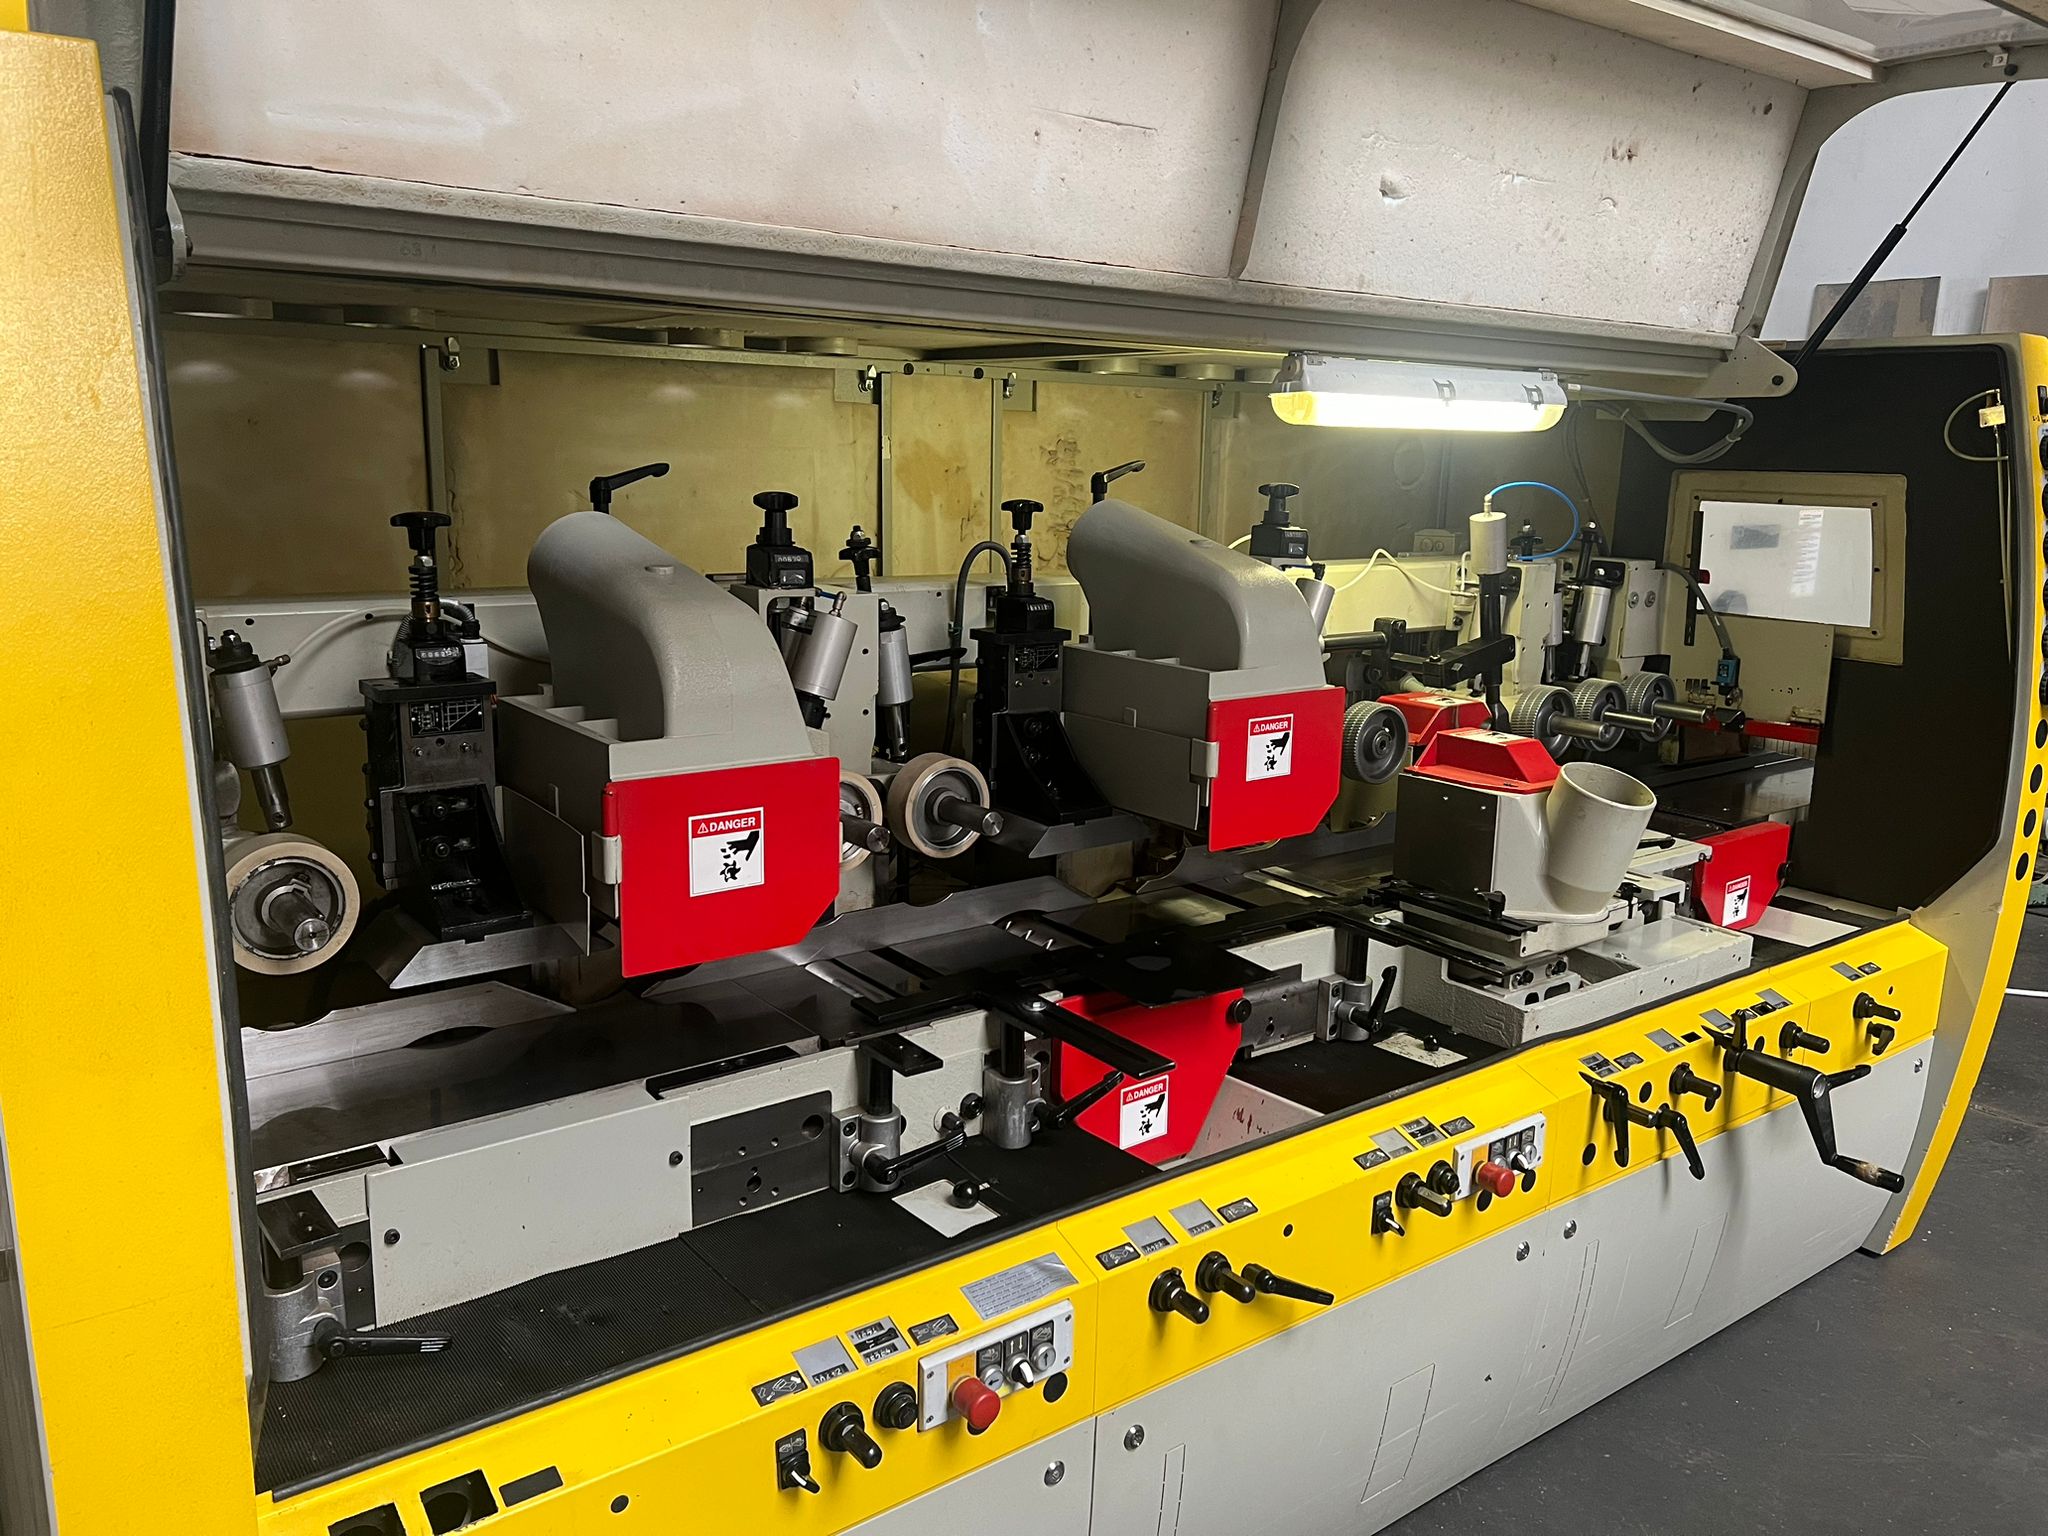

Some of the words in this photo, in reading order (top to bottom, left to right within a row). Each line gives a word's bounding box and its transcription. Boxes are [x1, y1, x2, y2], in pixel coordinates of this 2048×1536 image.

[1260, 720, 1289, 732] DANGER
[709, 816, 756, 832] DANGER
[1133, 1082, 1164, 1100] DANGER
